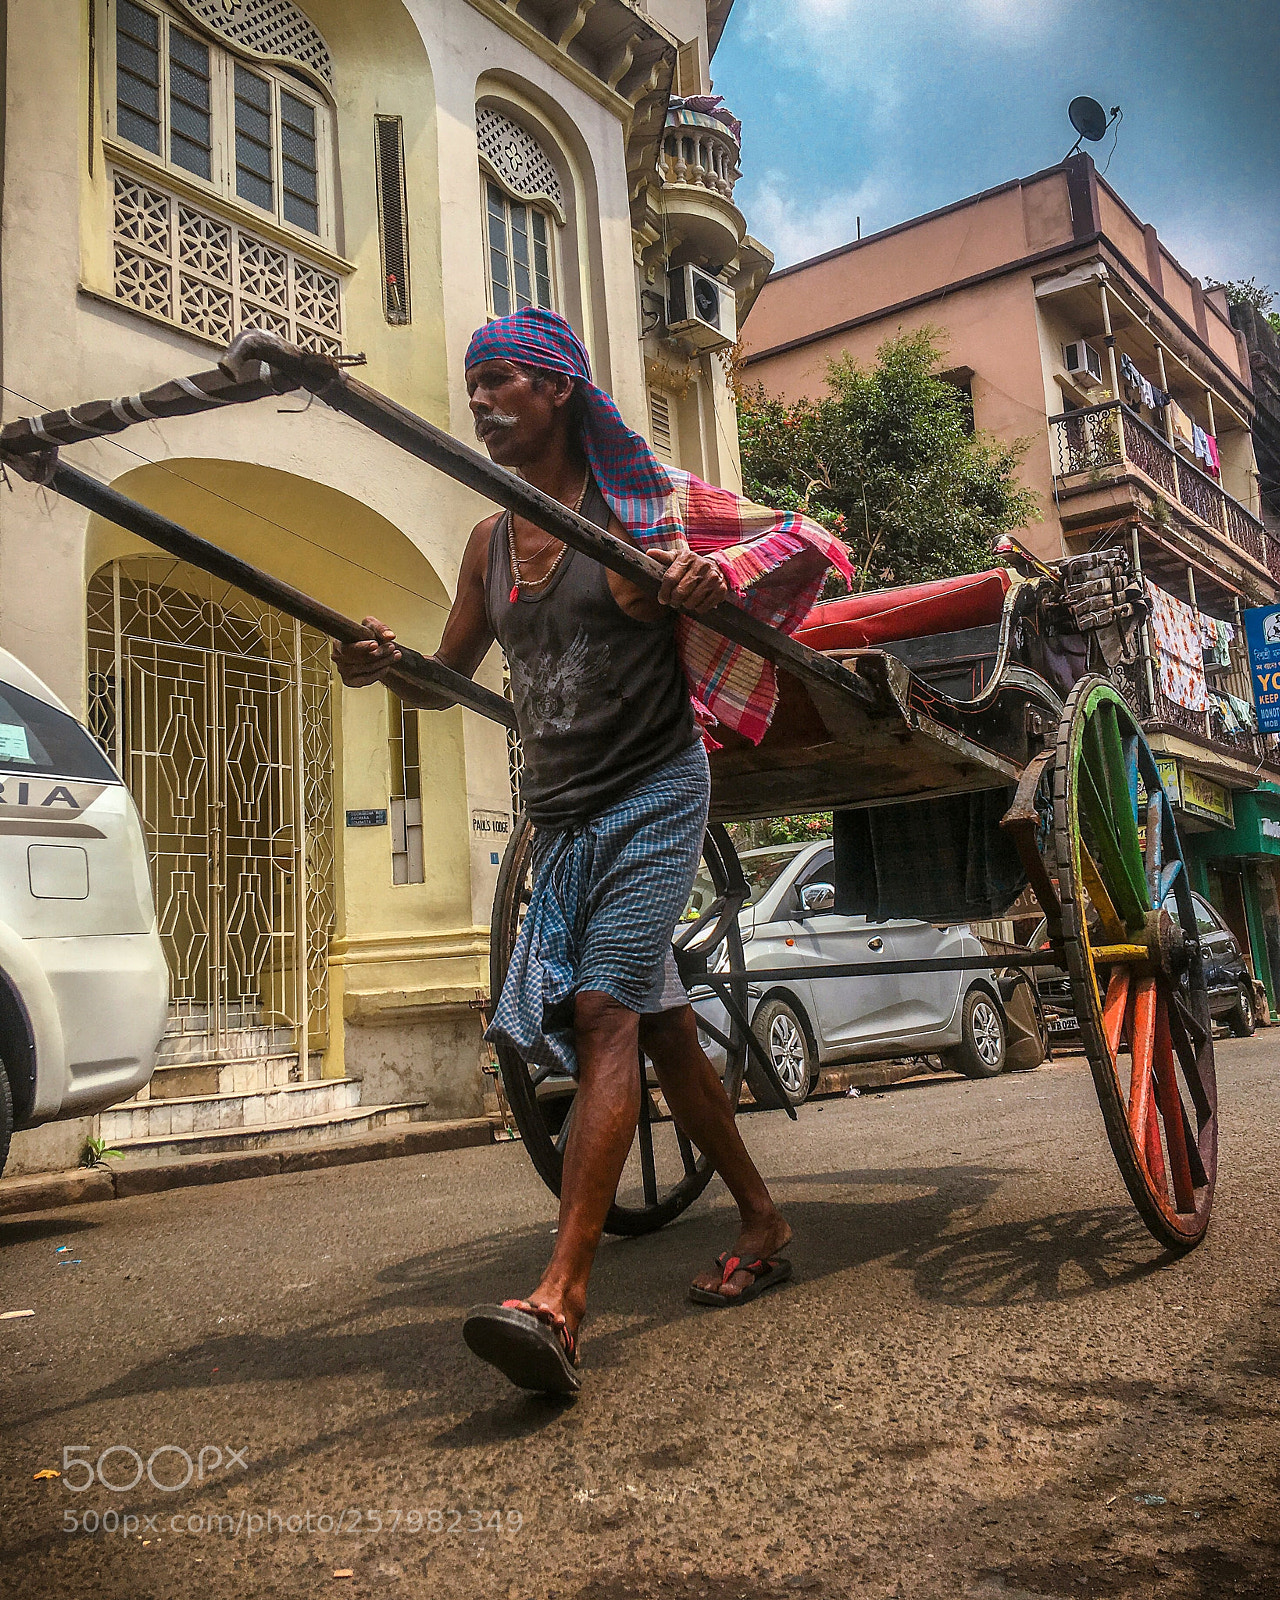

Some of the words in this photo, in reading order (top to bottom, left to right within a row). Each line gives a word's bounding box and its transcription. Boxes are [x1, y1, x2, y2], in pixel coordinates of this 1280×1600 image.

[1259, 693, 1279, 705] KEEP
[1260, 707, 1280, 719] MONOT
[0, 781, 80, 809] IA
[492, 820, 509, 833] LODGE
